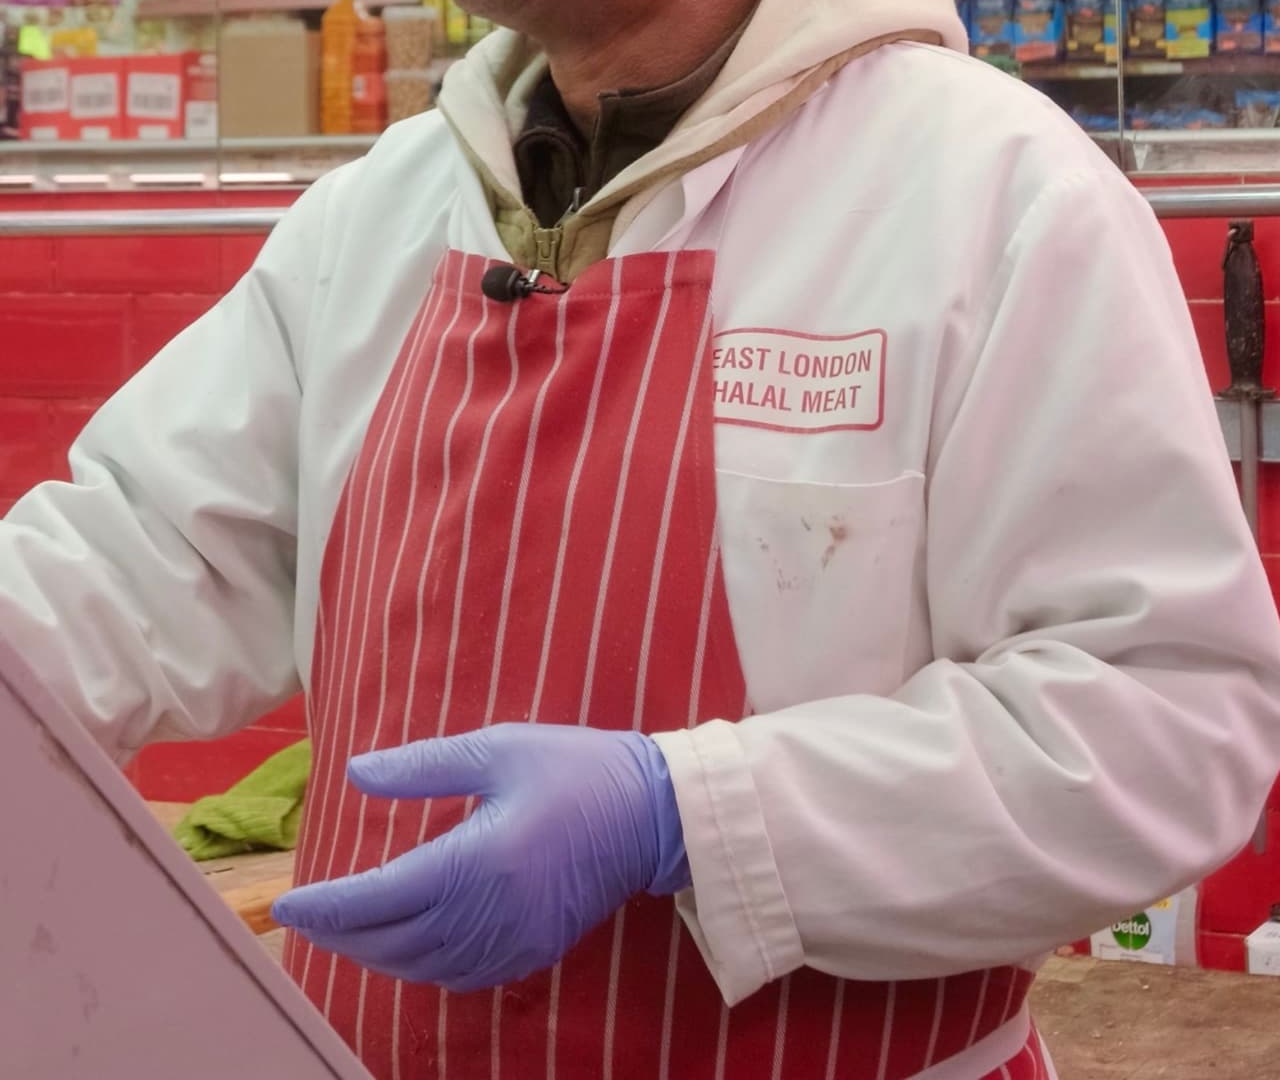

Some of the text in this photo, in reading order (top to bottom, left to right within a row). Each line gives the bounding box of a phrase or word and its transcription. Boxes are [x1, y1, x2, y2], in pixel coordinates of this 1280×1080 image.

[712, 346, 872, 379] EAST LONDON
[713, 380, 862, 414] HALAL MEAT
